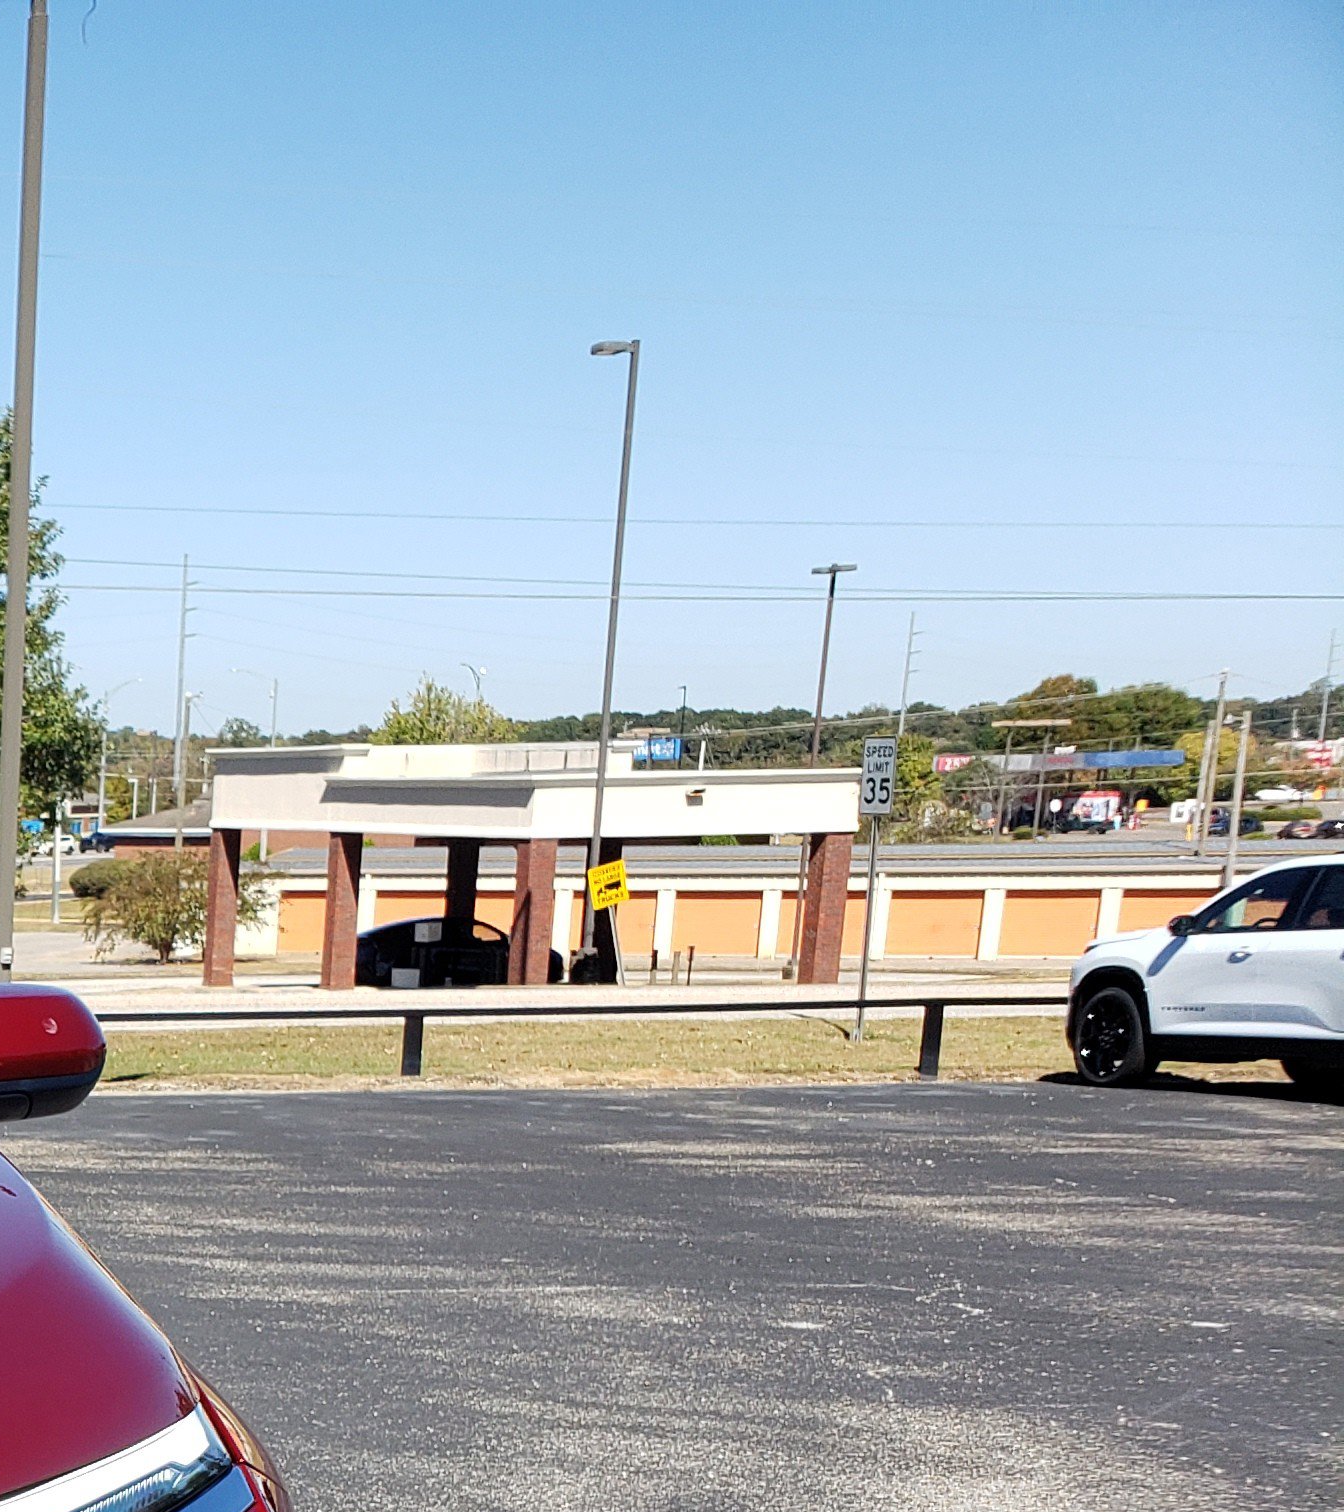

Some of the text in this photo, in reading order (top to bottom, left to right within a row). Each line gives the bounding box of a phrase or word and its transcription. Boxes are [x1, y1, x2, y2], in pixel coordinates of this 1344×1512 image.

[865, 745, 894, 758] SPEED
[867, 761, 890, 774] LIMIT
[863, 777, 891, 804] 35
